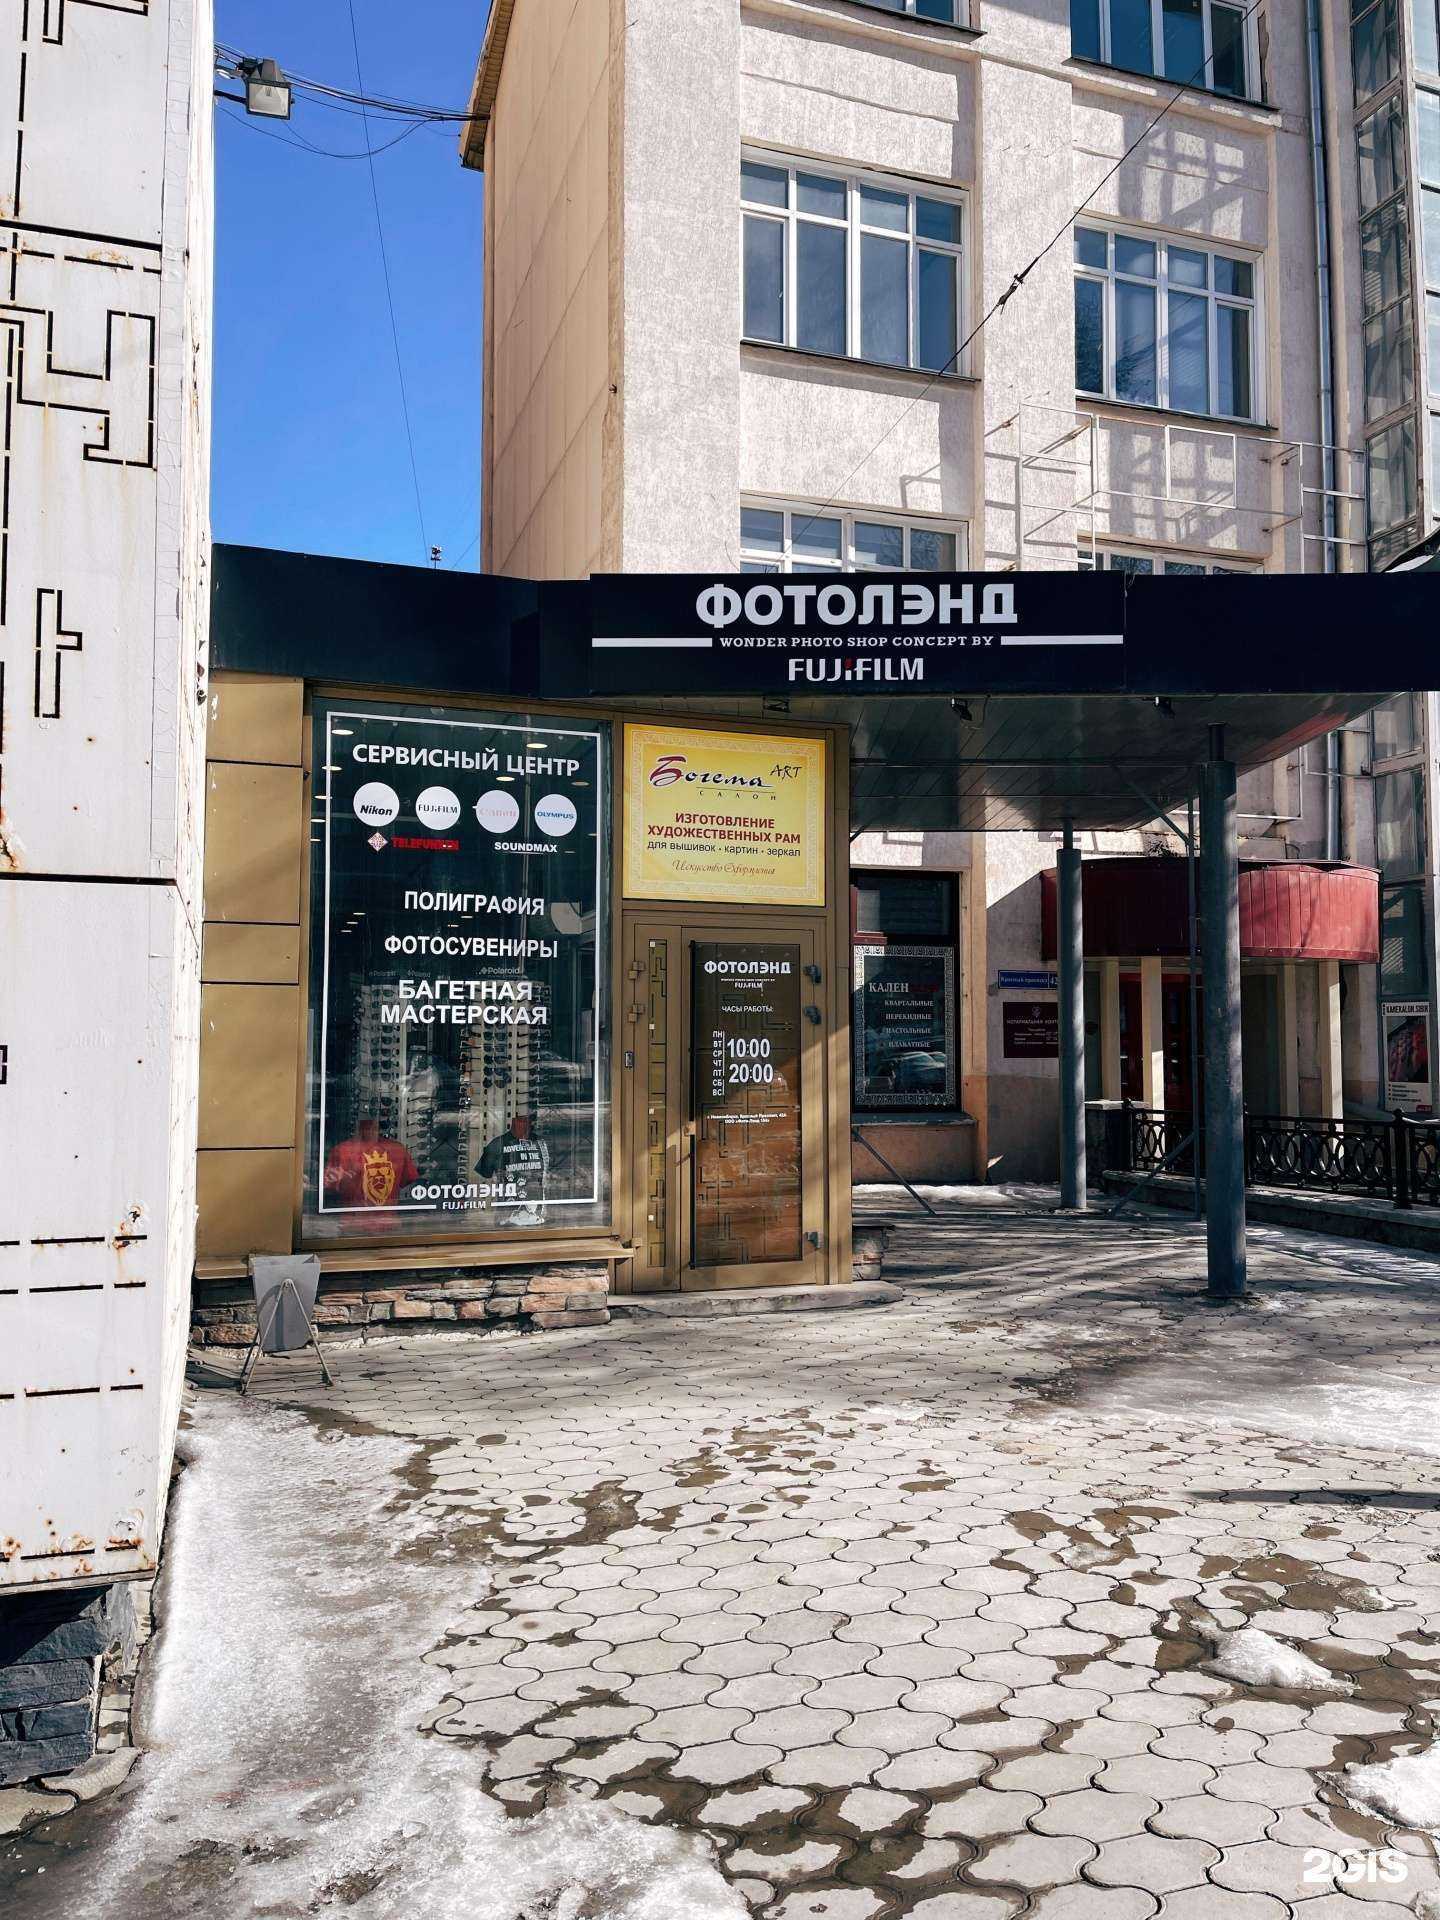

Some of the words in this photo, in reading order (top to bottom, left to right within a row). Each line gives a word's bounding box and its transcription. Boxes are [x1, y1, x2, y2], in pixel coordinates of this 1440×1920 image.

[695, 583, 1018, 628] ФОТОЛЭНД
[719, 637, 788, 648] WONDER
[792, 637, 844, 648] PHOTO
[847, 636, 889, 648] SHOP
[892, 635, 967, 647] CONCEPT
[972, 635, 994, 646] BY
[352, 743, 500, 771] СЕРВИСНЫЙ
[507, 754, 580, 777] ЦЕНТР
[650, 755, 772, 787] Богема
[770, 764, 802, 781] ART
[698, 790, 777, 801] САЛОН
[360, 804, 393, 816] Nikon
[537, 811, 575, 820] OLYMPUS
[675, 812, 775, 829] ИЗГОТОВЛЕНИЕ
[647, 825, 772, 844] ХУДОЖЕСТВЕННЫХ
[774, 833, 800, 844] РАМ
[494, 841, 558, 853] SOUNDMAX
[647, 840, 667, 850] для
[669, 841, 716, 853] вышивок
[724, 845, 758, 856] картин
[767, 848, 800, 858] зеркал
[404, 890, 545, 916] ПОЛИГРАФИЯ
[384, 935, 558, 958] ФОТОСУВЕНИРЫ
[487, 966, 520, 975] Polaroid
[704, 961, 791, 974] ФОТОЛЭНД
[399, 979, 532, 1001] БАГЕТНАЯ
[381, 1004, 547, 1024] МАСТЕРСКАЯ
[721, 1005, 742, 1013] ЧАСЫ
[713, 1040, 723, 1048] ВТ
[727, 1038, 770, 1058] 10:00
[712, 1050, 722, 1058] СР
[728, 1063, 774, 1083] 20:00
[411, 1183, 517, 1200] ФОТОЛЭНД
